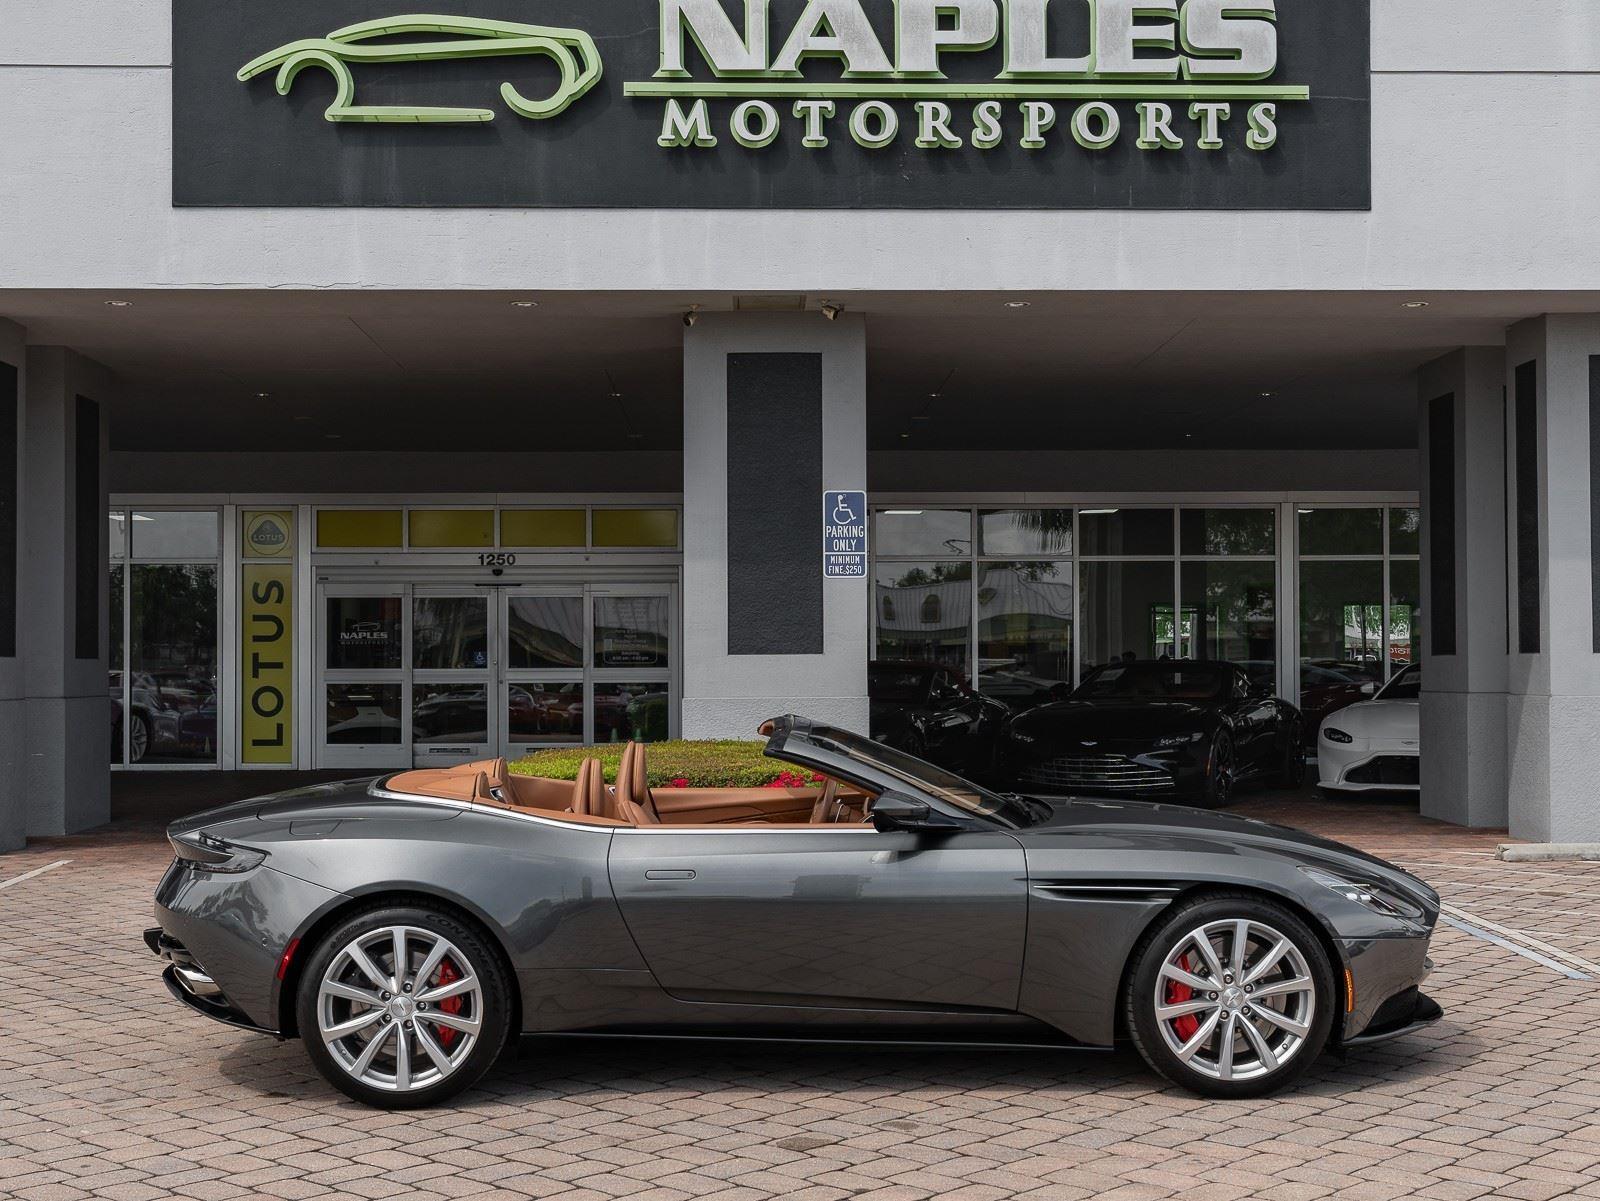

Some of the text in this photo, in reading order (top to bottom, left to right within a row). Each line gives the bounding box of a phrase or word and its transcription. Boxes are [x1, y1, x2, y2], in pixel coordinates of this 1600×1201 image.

[654, 0, 1278, 81] NAPLES
[657, 98, 1279, 150] MOTORSPORTS
[253, 534, 284, 542] LOTUS
[826, 525, 864, 538] PARKING
[833, 539, 857, 552] ONLY
[478, 553, 516, 566] 1250
[830, 555, 860, 564] MINIMUM
[828, 565, 862, 575] FINE $250
[340, 631, 389, 640] NAPLES
[251, 579, 285, 747] LOTUS
